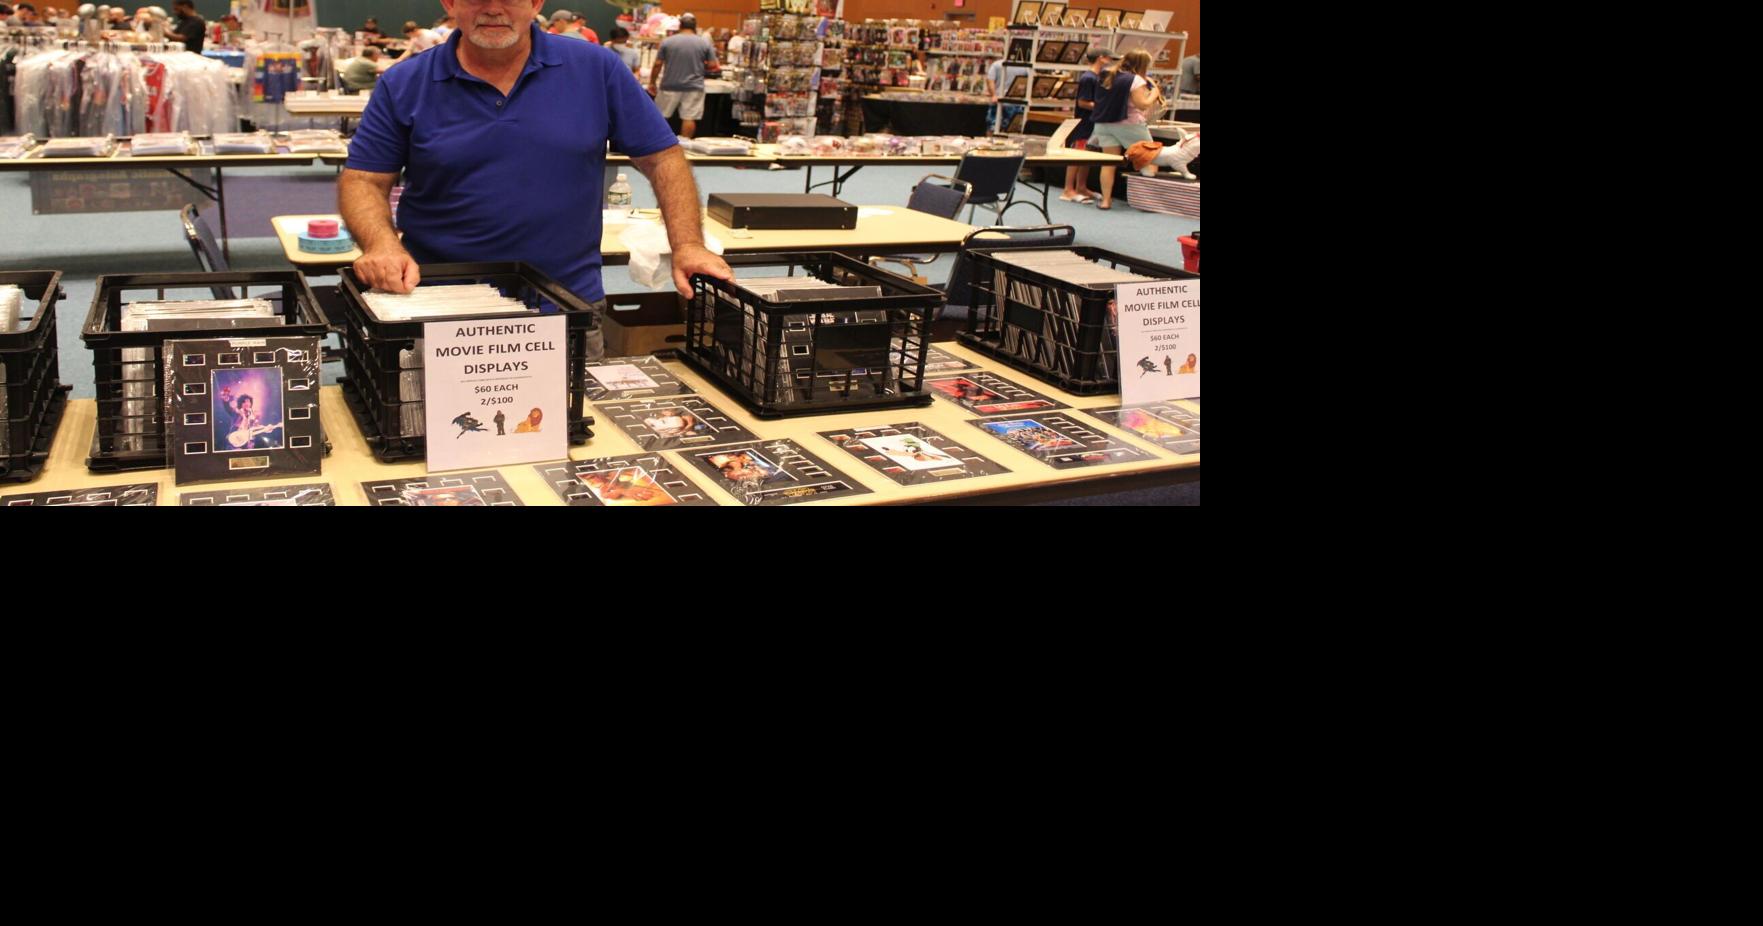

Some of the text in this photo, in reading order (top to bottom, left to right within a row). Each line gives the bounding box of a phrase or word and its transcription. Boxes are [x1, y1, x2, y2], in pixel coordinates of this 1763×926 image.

[1136, 285, 1188, 296] AUTHENTIC
[1124, 299, 1200, 312] MOVIE FILM CELL
[1142, 315, 1185, 326] DISPLAYS
[455, 323, 536, 338] AUTHENTIC
[435, 341, 555, 357] MOVIE FILM CELL
[464, 361, 529, 375] DISPLAYS
[474, 383, 519, 394] $60 EACH
[480, 396, 514, 406] 2/$100
